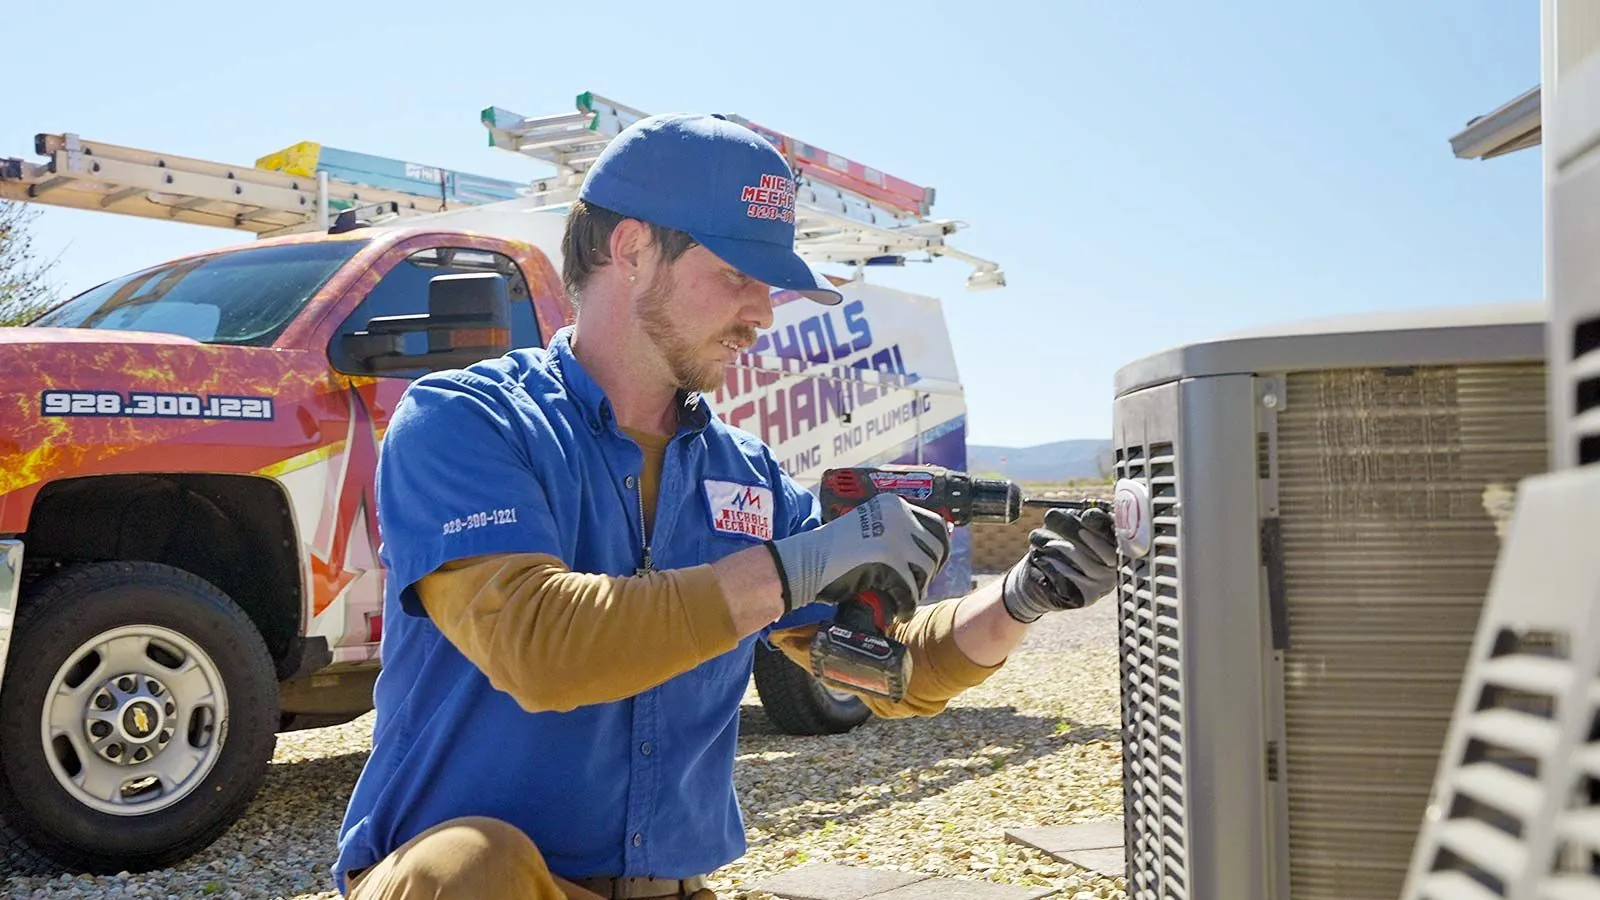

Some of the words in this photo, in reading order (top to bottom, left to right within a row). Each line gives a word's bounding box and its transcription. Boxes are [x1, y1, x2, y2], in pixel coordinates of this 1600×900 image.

[45, 393, 272, 419] 928.300.1221
[718, 344, 921, 445] CHANICAL
[833, 425, 862, 457] AND
[442, 508, 518, 536] 928-300-1221
